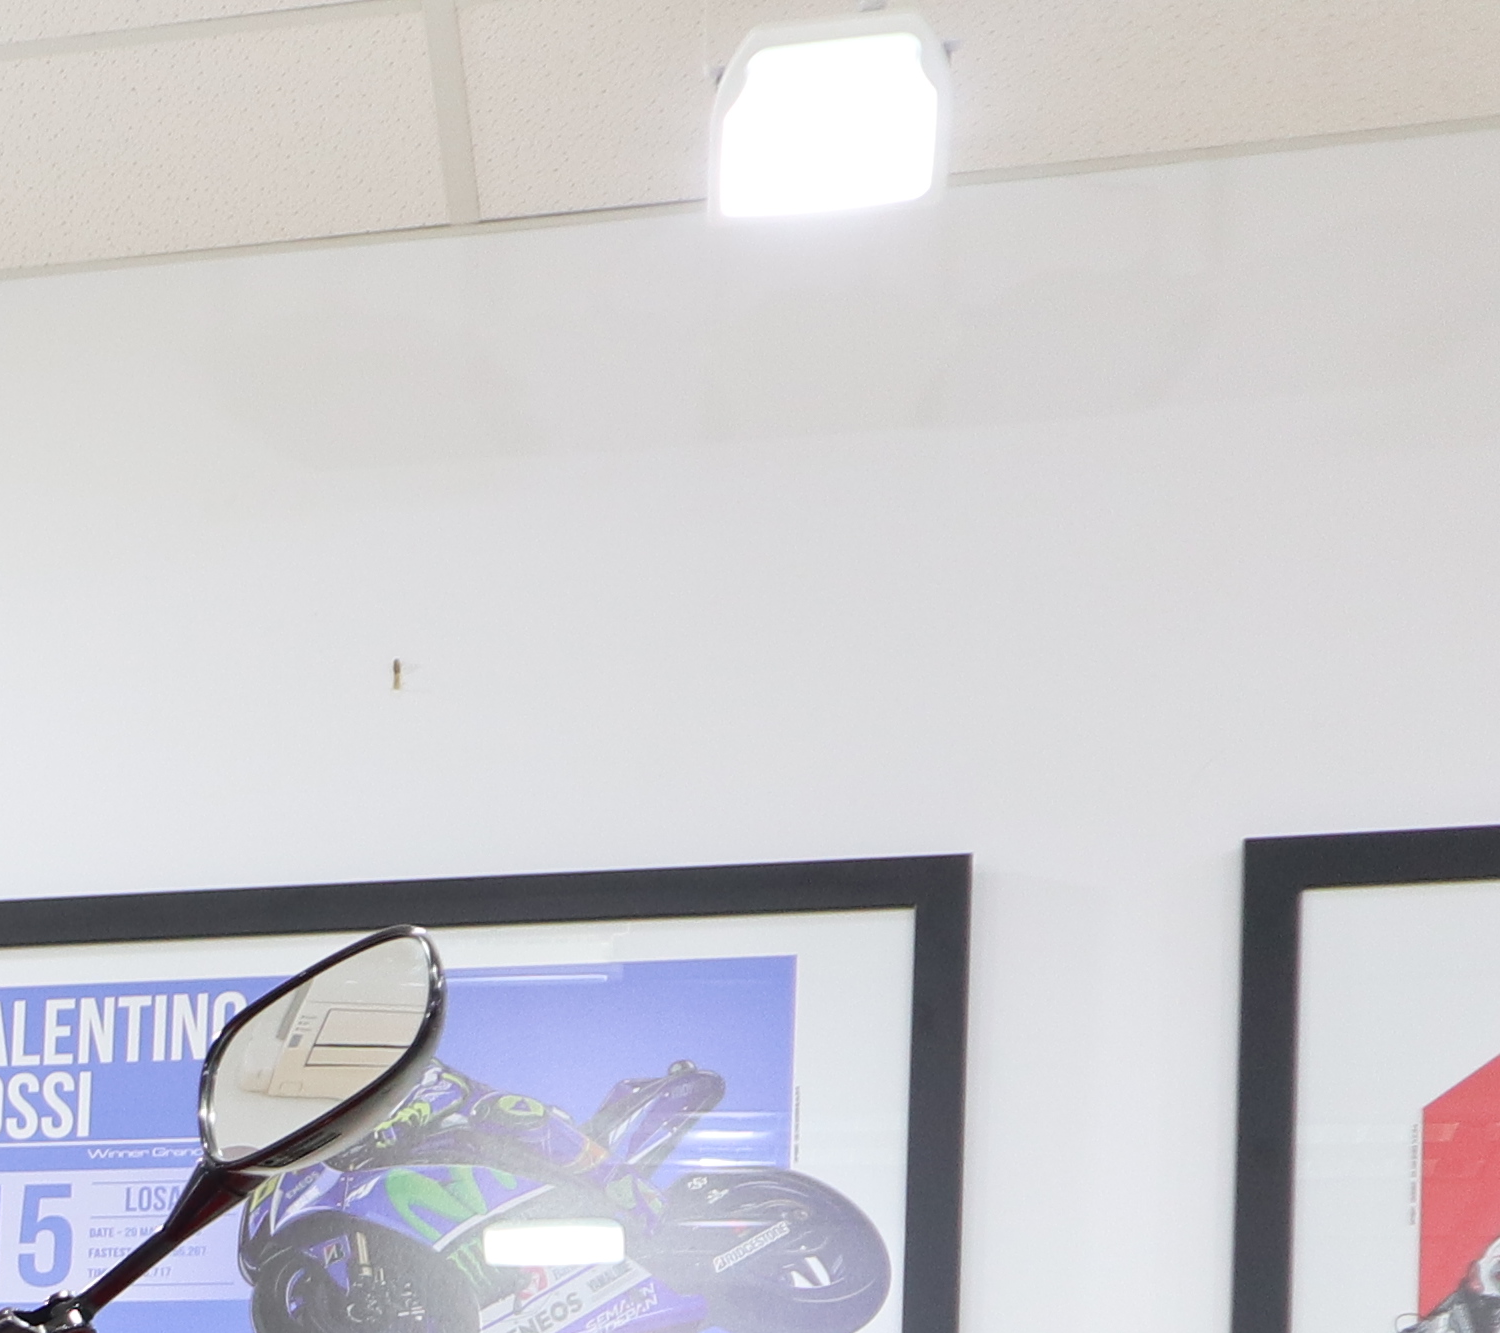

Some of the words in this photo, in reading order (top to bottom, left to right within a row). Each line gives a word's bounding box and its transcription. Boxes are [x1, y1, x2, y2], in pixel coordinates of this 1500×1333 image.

[87, 1148, 150, 1159] Winner
[125, 1185, 180, 1212] LOSA
[89, 1227, 113, 1238] DATE
